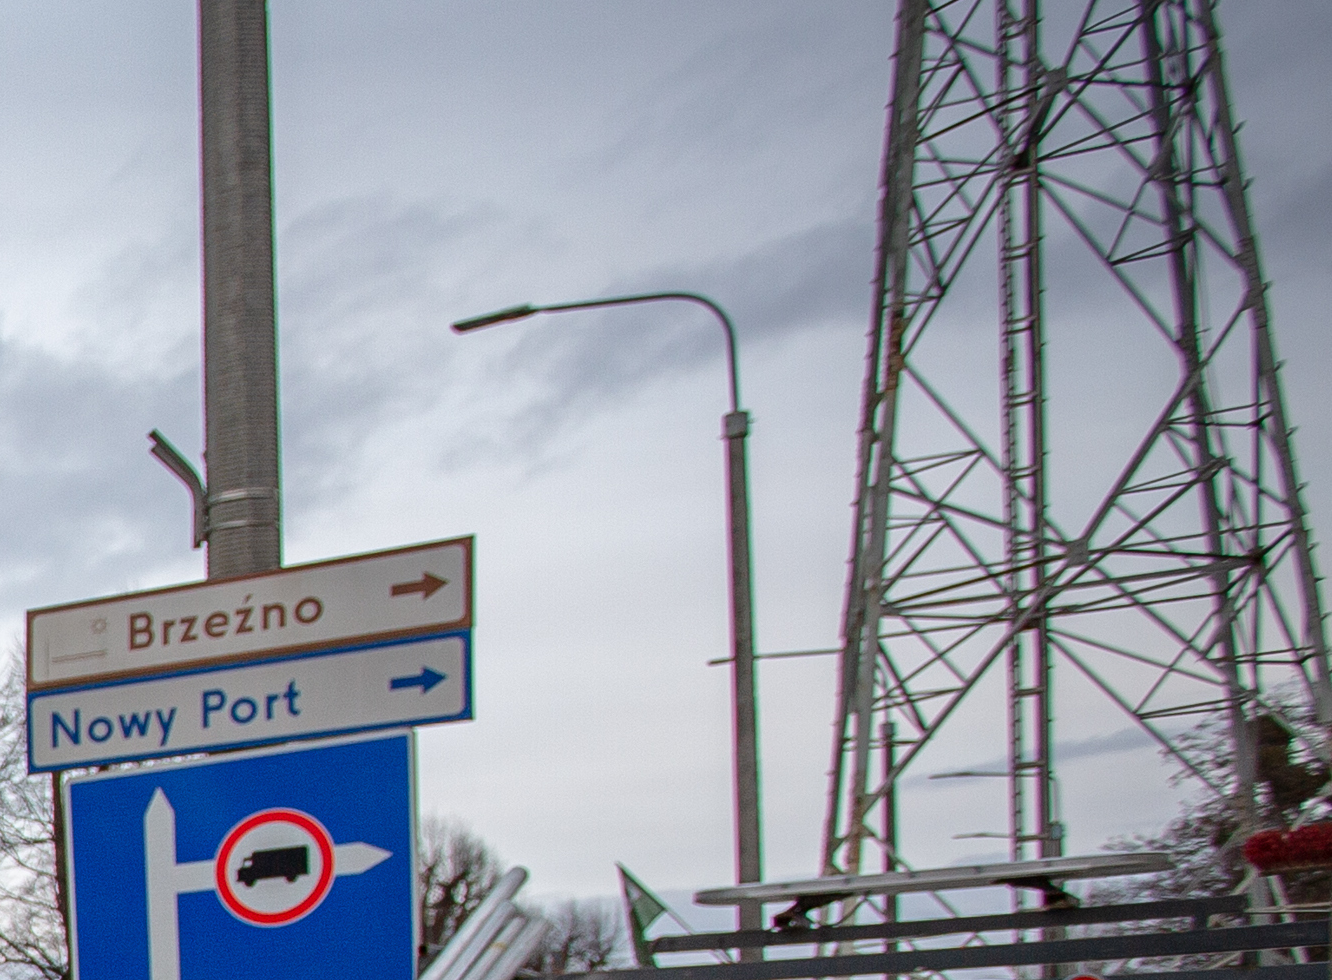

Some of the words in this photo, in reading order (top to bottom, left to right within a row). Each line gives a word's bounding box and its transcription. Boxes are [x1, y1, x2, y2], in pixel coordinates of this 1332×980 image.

[128, 594, 324, 651] Brzeźno
[51, 707, 177, 747] Nowy
[202, 679, 302, 728] Port
